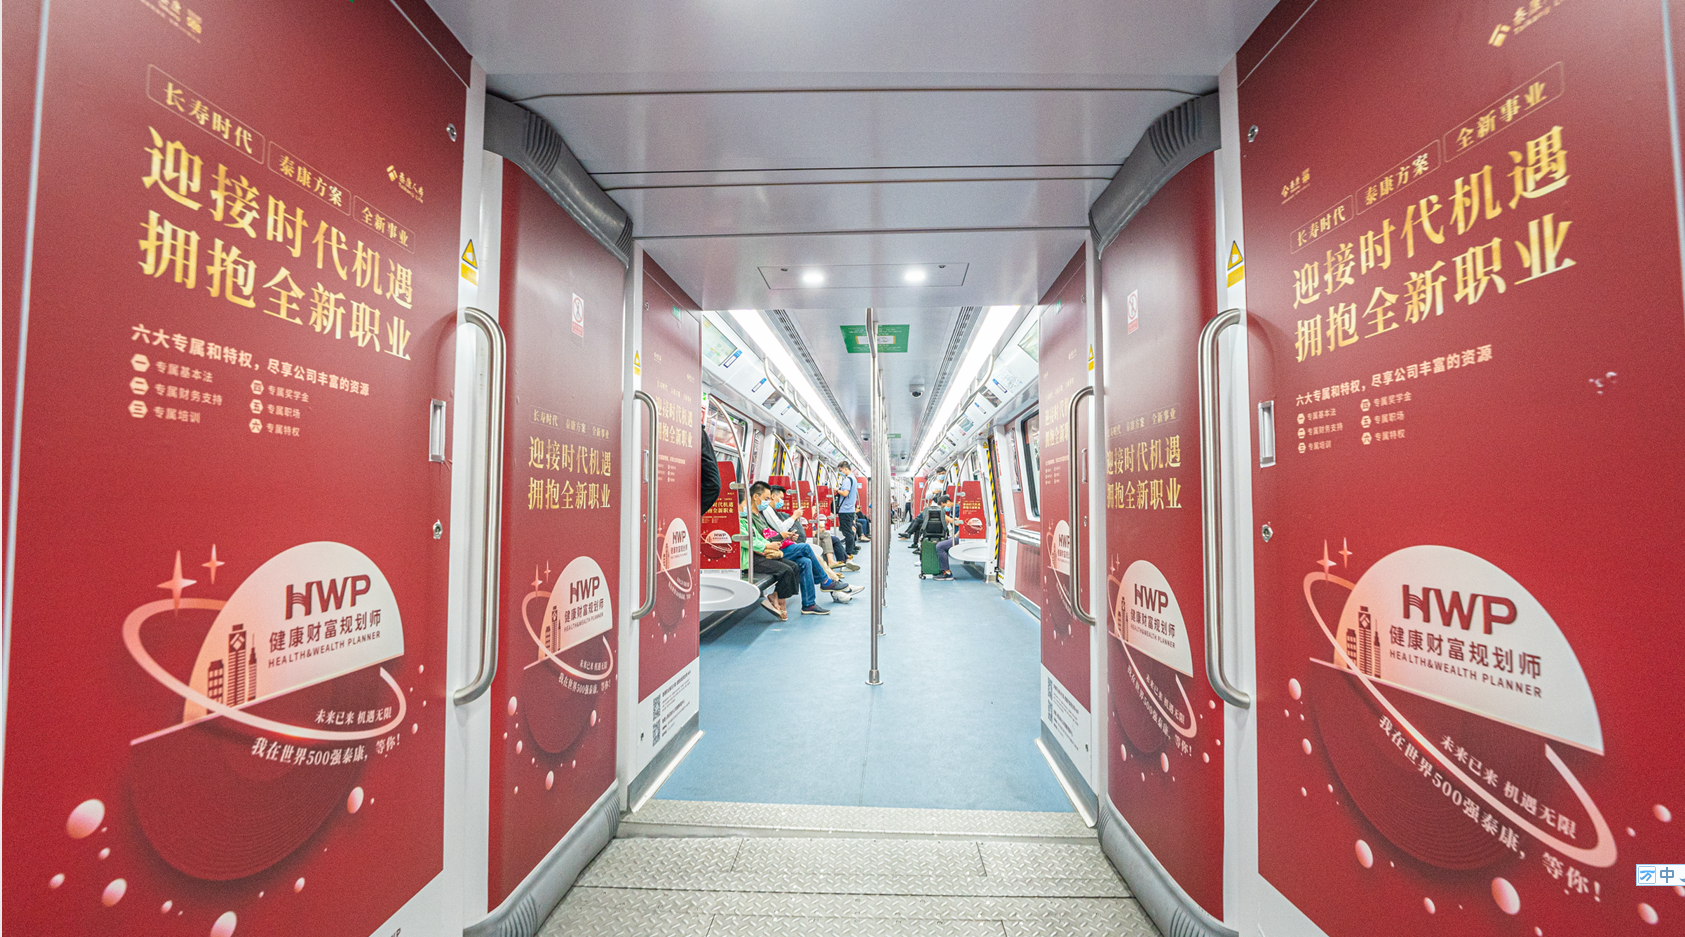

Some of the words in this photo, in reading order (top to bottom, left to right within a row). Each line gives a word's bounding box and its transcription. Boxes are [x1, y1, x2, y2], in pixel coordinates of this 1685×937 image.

[164, 82, 253, 154] 长寿时代
[1456, 81, 1547, 152] 全新事业
[279, 155, 342, 207] 泰康方案
[1364, 153, 1429, 206] 泰康方案
[142, 126, 414, 310] 迎接时代机遇
[361, 207, 409, 248] 全新事业
[1292, 125, 1571, 310] 迎接时代机遇
[1295, 204, 1346, 247] 长寿时代
[138, 210, 411, 361] 拥抱全新职业
[1294, 212, 1577, 363] 拥抱全新职业
[131, 324, 370, 397] 六大专属和特权，尽享公司丰富的资源
[155, 361, 213, 383] 专属基本法
[1295, 343, 1493, 407] 六大专属和特权，尽享公司丰富的资源
[154, 383, 222, 406] 专属财务支持
[266, 403, 301, 419] 专属职场
[267, 384, 309, 403] 专属奖学金
[1373, 391, 1412, 407] 专属奖学金
[153, 406, 201, 424] 专属培训
[266, 423, 301, 437] 专属特权
[1374, 410, 1405, 424] 专属职场
[1374, 429, 1406, 442] 专属特权
[529, 435, 611, 477] 迎接时代机遇
[1106, 434, 1182, 475] 迎接时代机遇
[528, 477, 611, 510] 拥抱全新职业
[1106, 477, 1182, 510] 拥抱全新职业
[285, 574, 371, 620] HWP
[569, 576, 600, 604] HWP
[1134, 583, 1169, 614] HWP
[1402, 584, 1517, 635] HWP
[269, 609, 383, 653] 健康财富规划师
[1130, 608, 1176, 639] 健康财富规划师
[268, 642, 345, 668] HEALTH&WEALTH
[347, 630, 381, 651] PLANNER
[1389, 625, 1542, 680] 健康财富规划师
[1390, 649, 1478, 681] HEALTH&WEALTH
[1481, 673, 1543, 699] PLANNER
[315, 708, 354, 725] 未来已来
[356, 706, 393, 724] 机遇无限
[1440, 734, 1498, 788] 未来已来
[1504, 781, 1577, 840] 机遇无限
